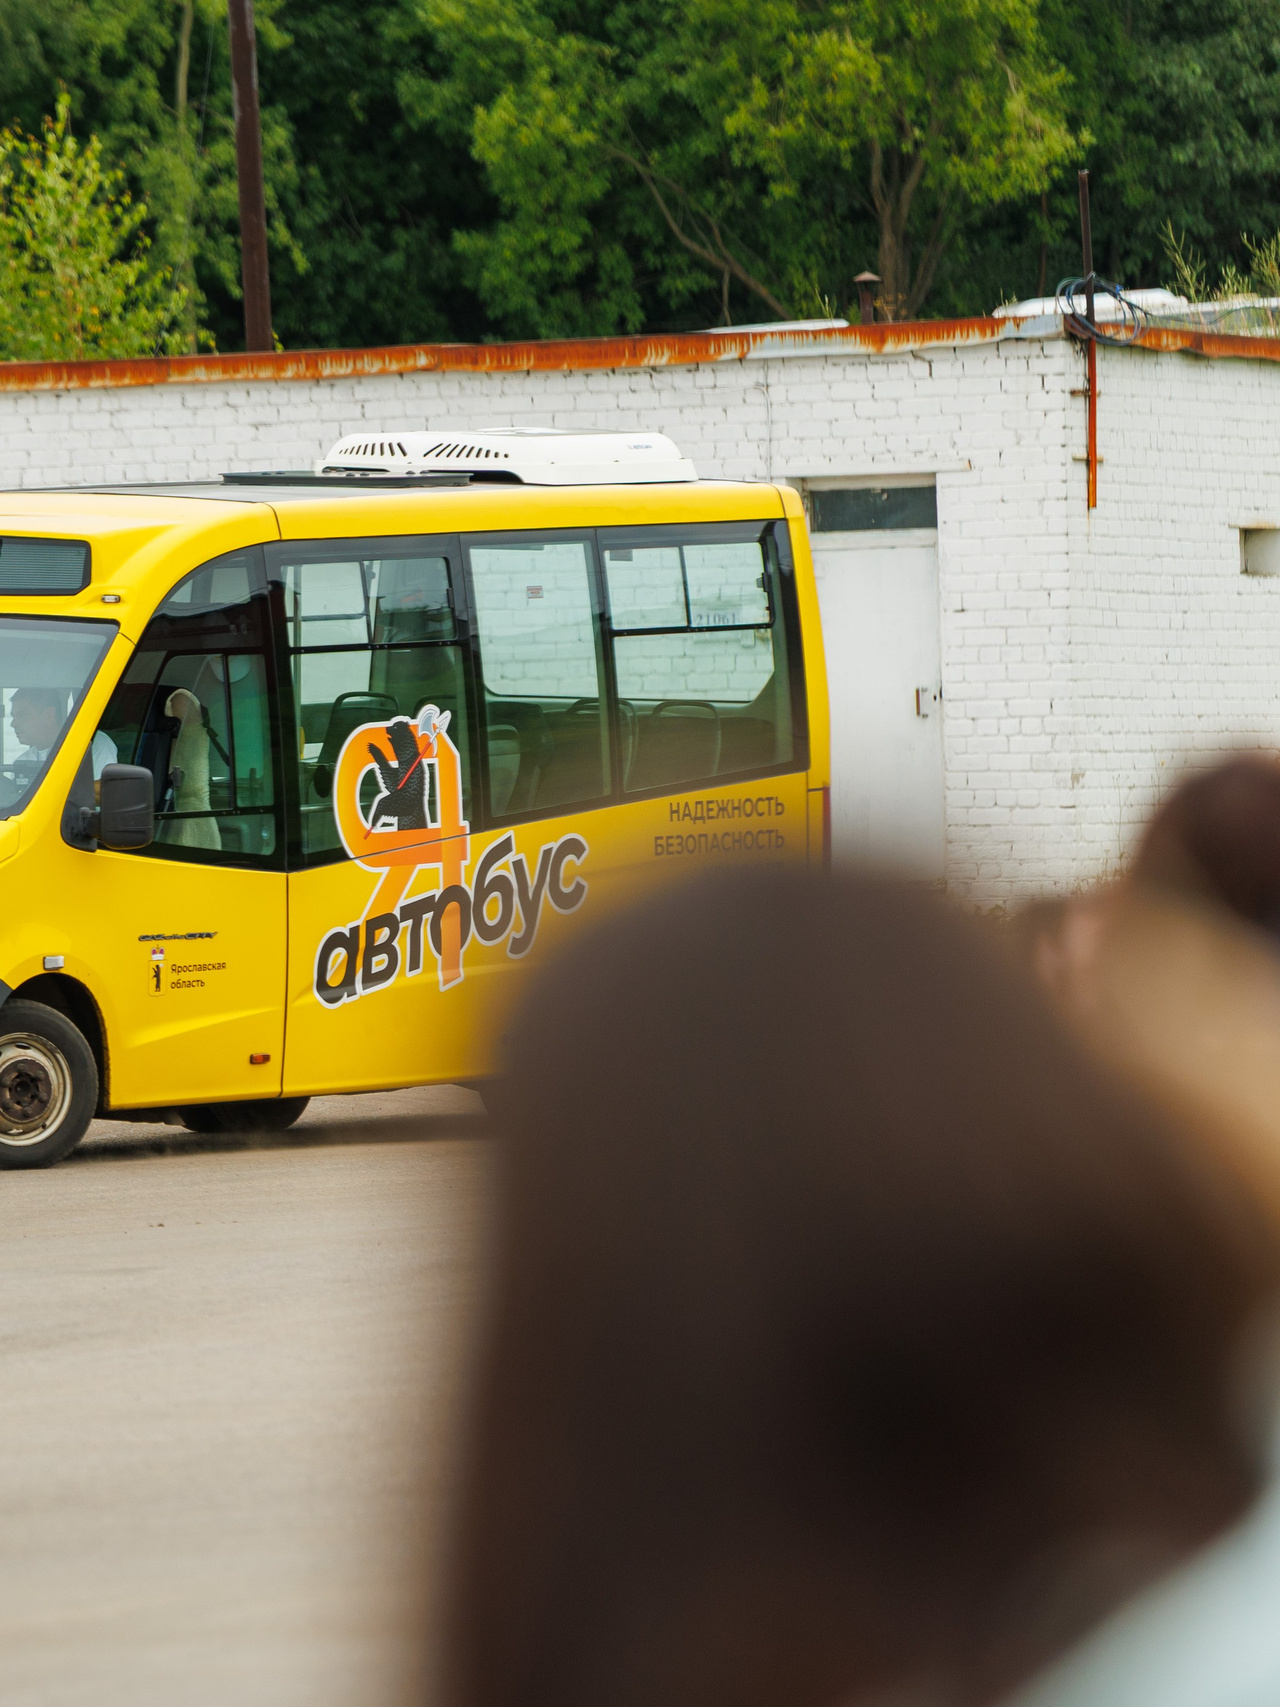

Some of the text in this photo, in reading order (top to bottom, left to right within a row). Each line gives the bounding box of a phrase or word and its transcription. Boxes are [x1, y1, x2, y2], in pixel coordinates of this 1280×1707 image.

[669, 796, 785, 825] НАДЕЖНОСТЬ
[654, 829, 785, 857] БЕЗОПАСНОСТЬ
[315, 831, 588, 1005] автобус
[170, 962, 227, 976] Ярославская
[170, 978, 206, 990] область
